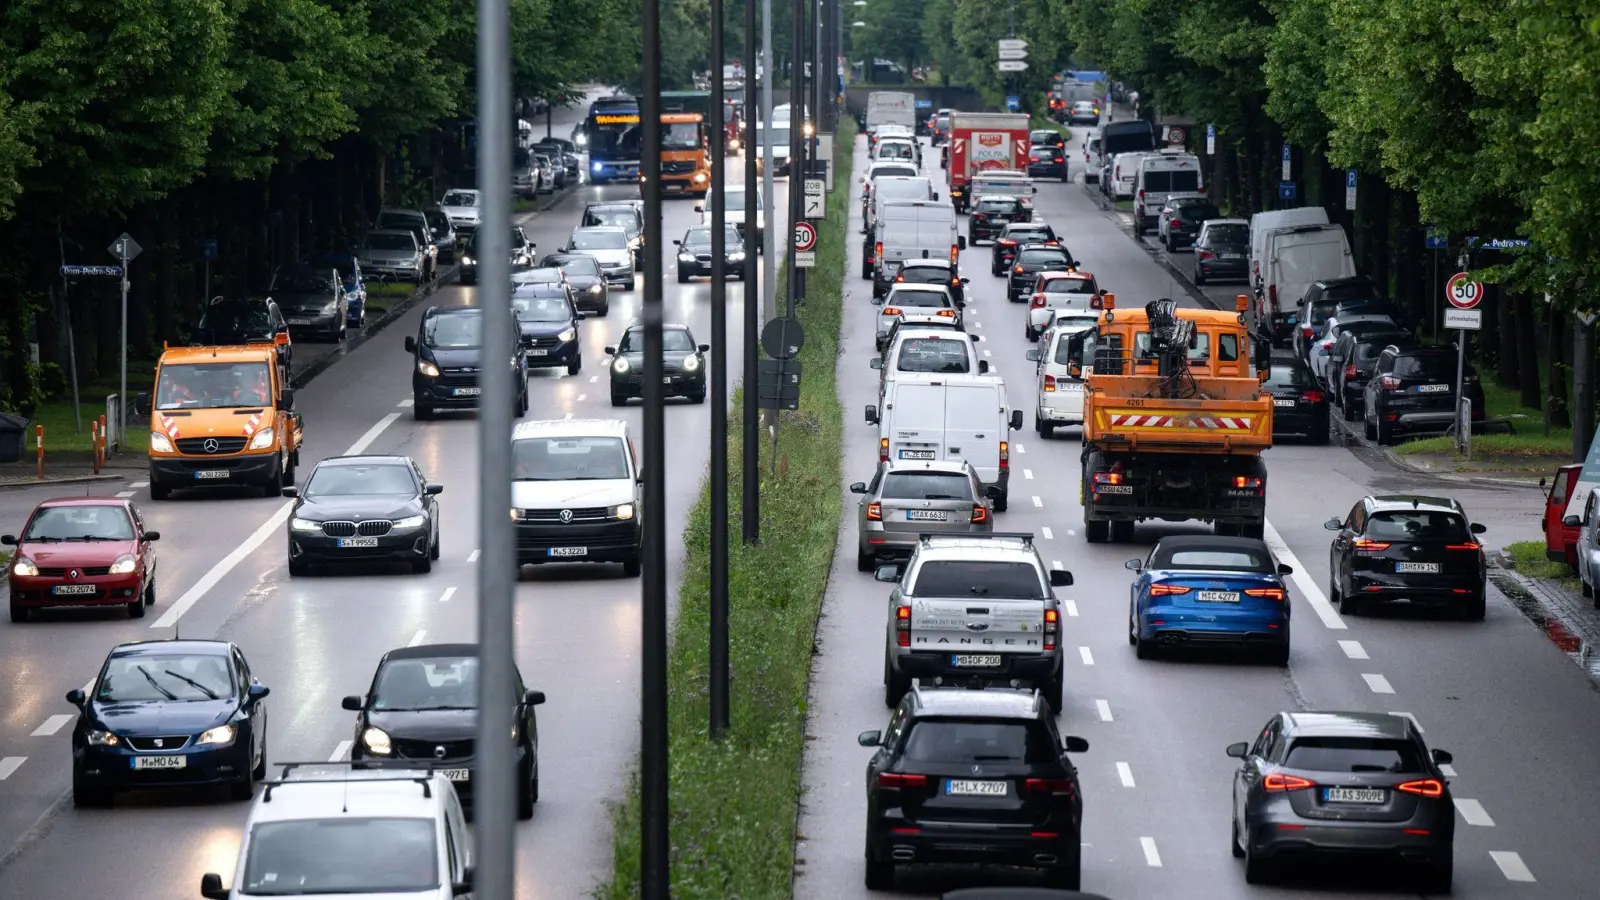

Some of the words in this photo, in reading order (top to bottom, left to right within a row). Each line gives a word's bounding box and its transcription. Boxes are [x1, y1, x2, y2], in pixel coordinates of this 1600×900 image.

[805, 182, 821, 190] ZOB
[795, 230, 810, 243] 50
[64, 266, 118, 276] Dom-Pedro-Str.
[1456, 283, 1475, 298] 50
[1218, 592, 1237, 600] 4277
[916, 637, 1038, 646] RANGER
[956, 655, 967, 664] MB
[972, 655, 984, 664] OF
[985, 655, 1000, 665] 200
[168, 757, 180, 766] 64
[952, 782, 959, 791] M
[966, 783, 978, 792] LX
[981, 783, 1005, 793] 2707
[1355, 791, 1382, 801] 3909E
